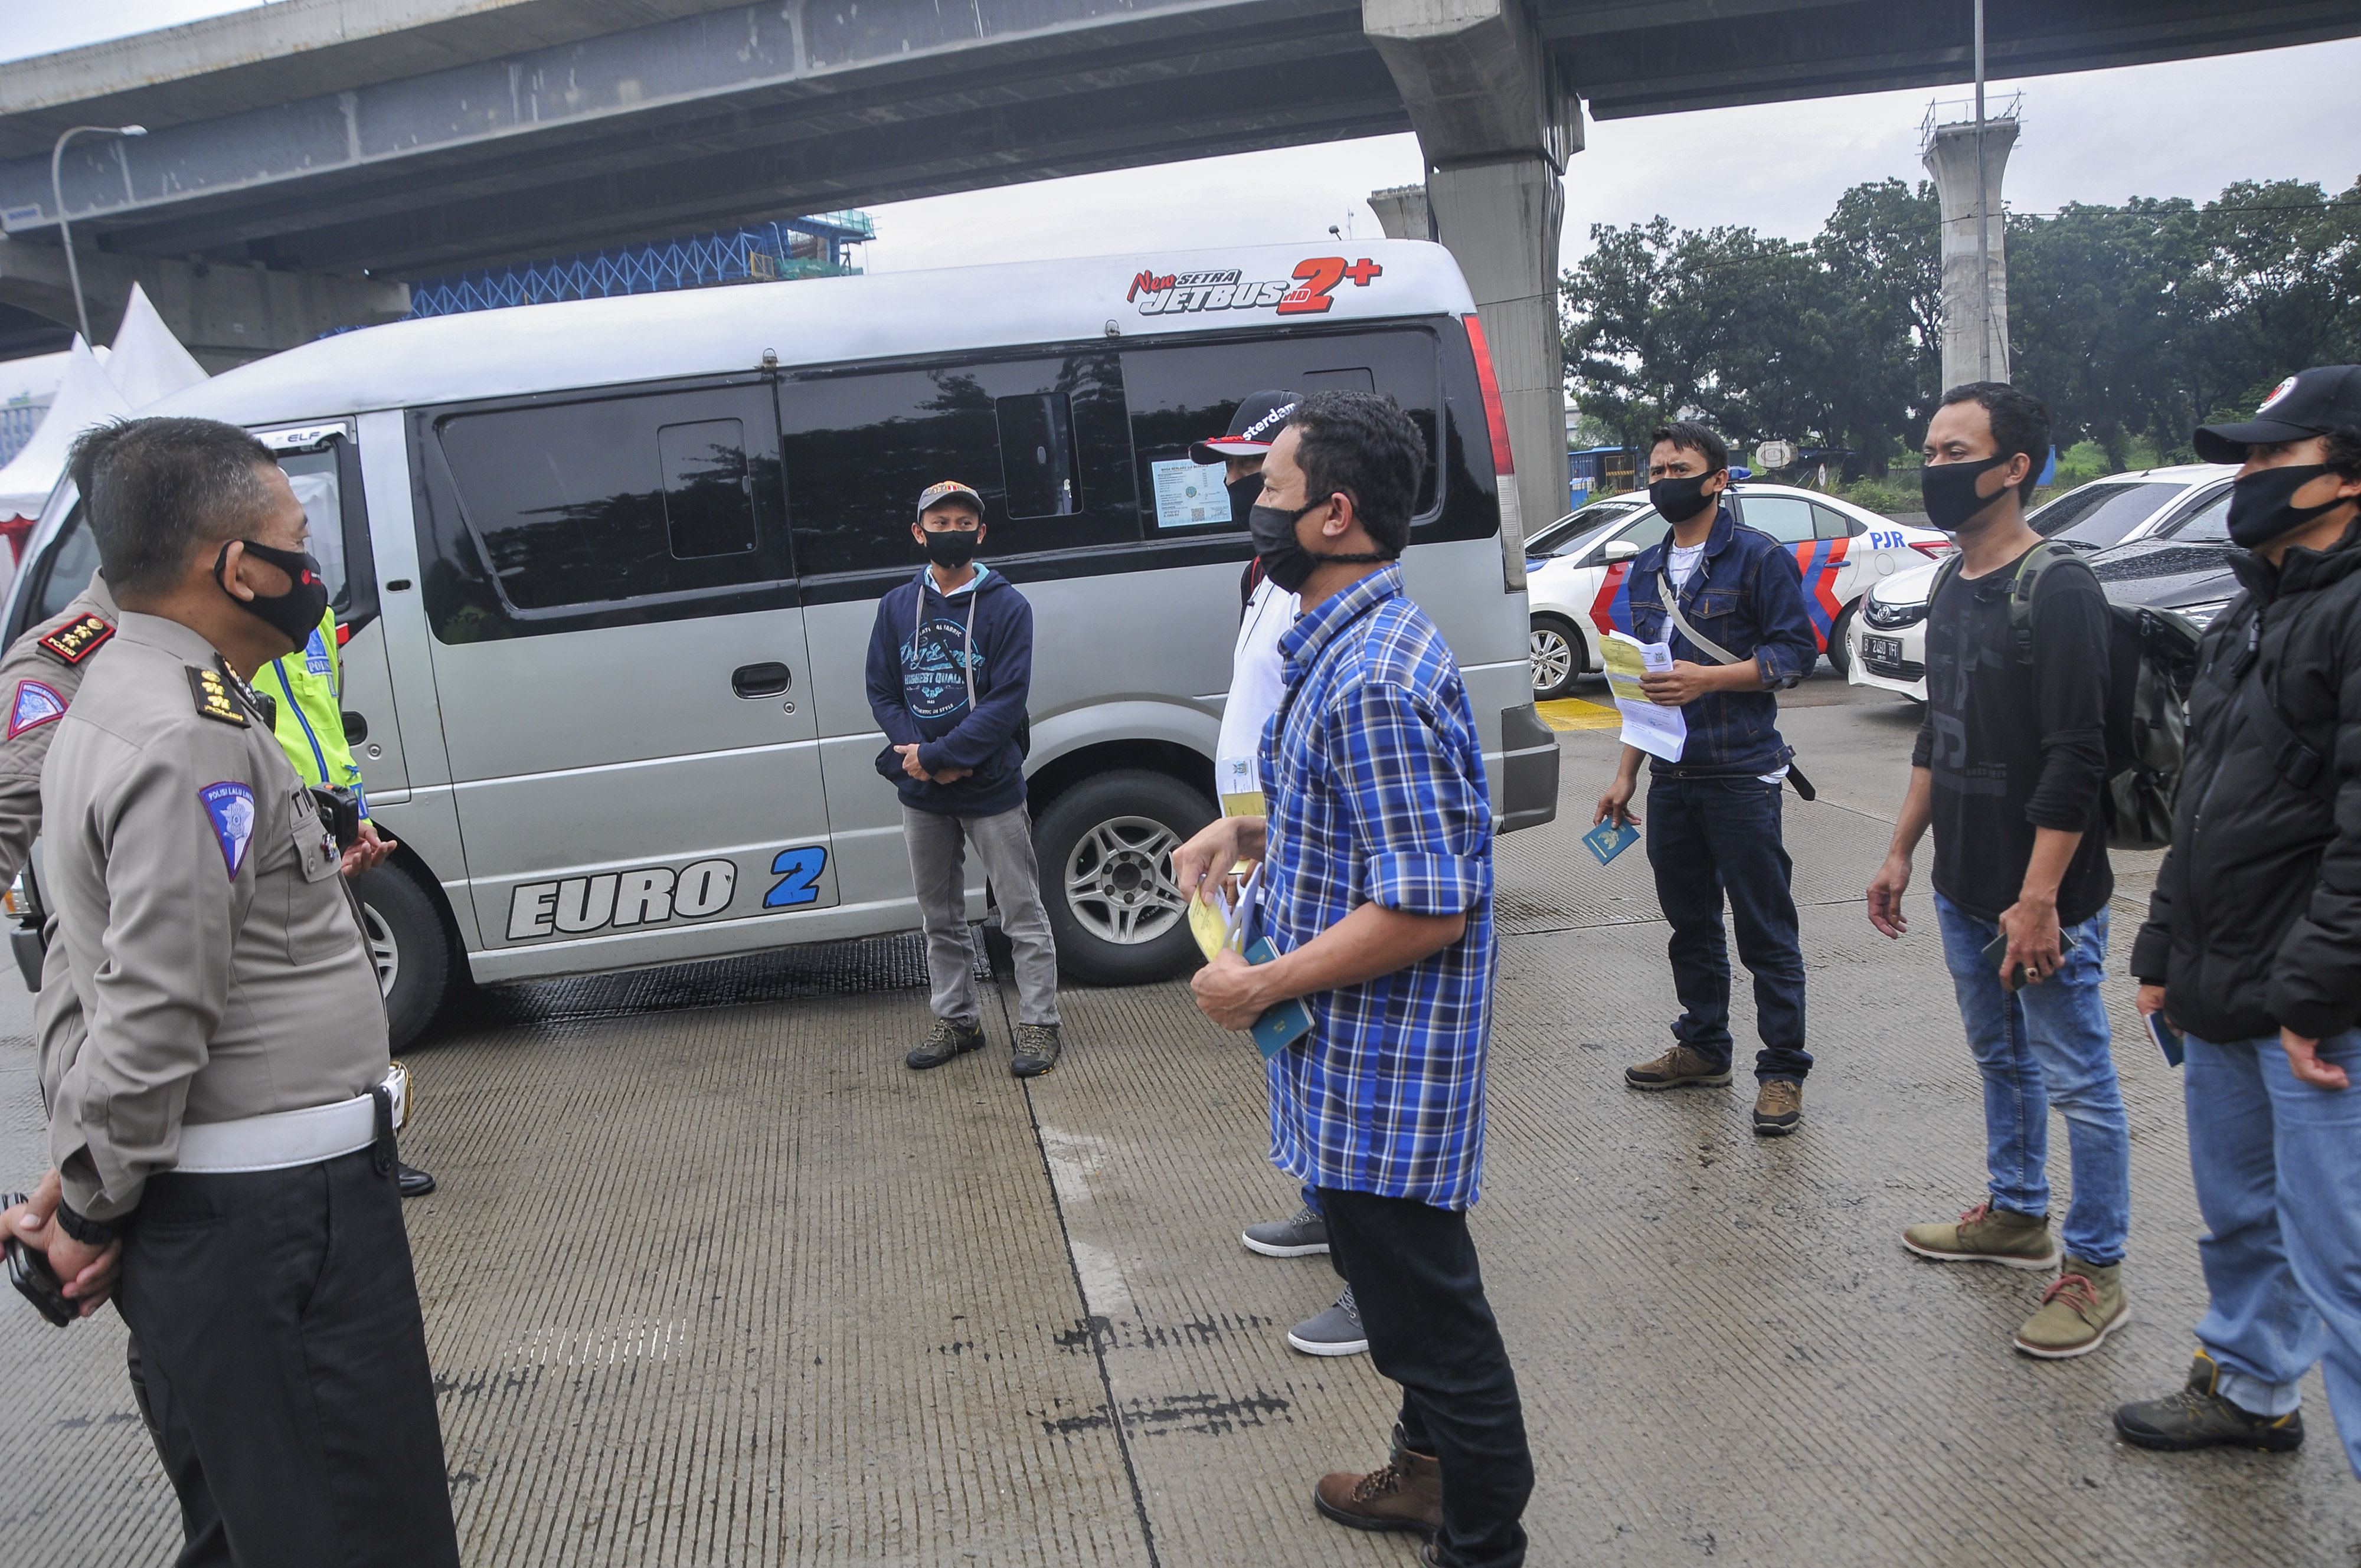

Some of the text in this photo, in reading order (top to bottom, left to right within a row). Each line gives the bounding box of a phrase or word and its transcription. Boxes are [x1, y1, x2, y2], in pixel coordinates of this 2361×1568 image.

[1128, 269, 1241, 302] New SETRA
[1139, 281, 1290, 315] JETBUS
[287, 431, 320, 442] ELF
[1869, 531, 1906, 549] PJR
[1864, 638, 1869, 652] B
[904, 673, 965, 685] HIGHEST QUALI
[208, 787, 255, 805] POLISI LALU LINTA
[505, 845, 828, 941] EURO 2
